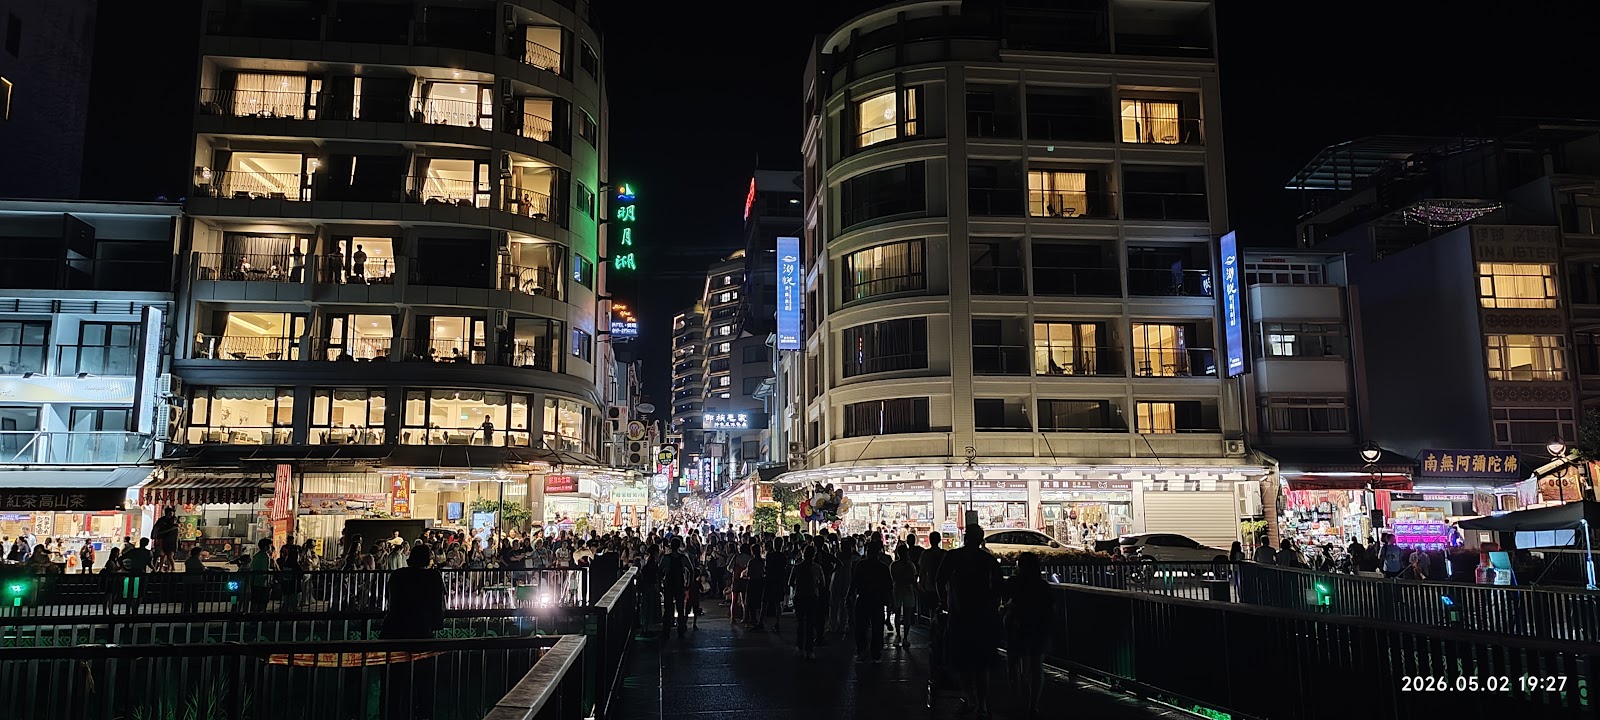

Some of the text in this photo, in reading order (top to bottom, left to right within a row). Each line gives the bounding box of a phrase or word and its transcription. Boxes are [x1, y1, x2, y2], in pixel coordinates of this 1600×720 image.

[615, 204, 637, 271] 明月湖
[1424, 453, 1518, 474] 南無阿彌陀佛
[0, 493, 86, 508] 紅茶高山茶
